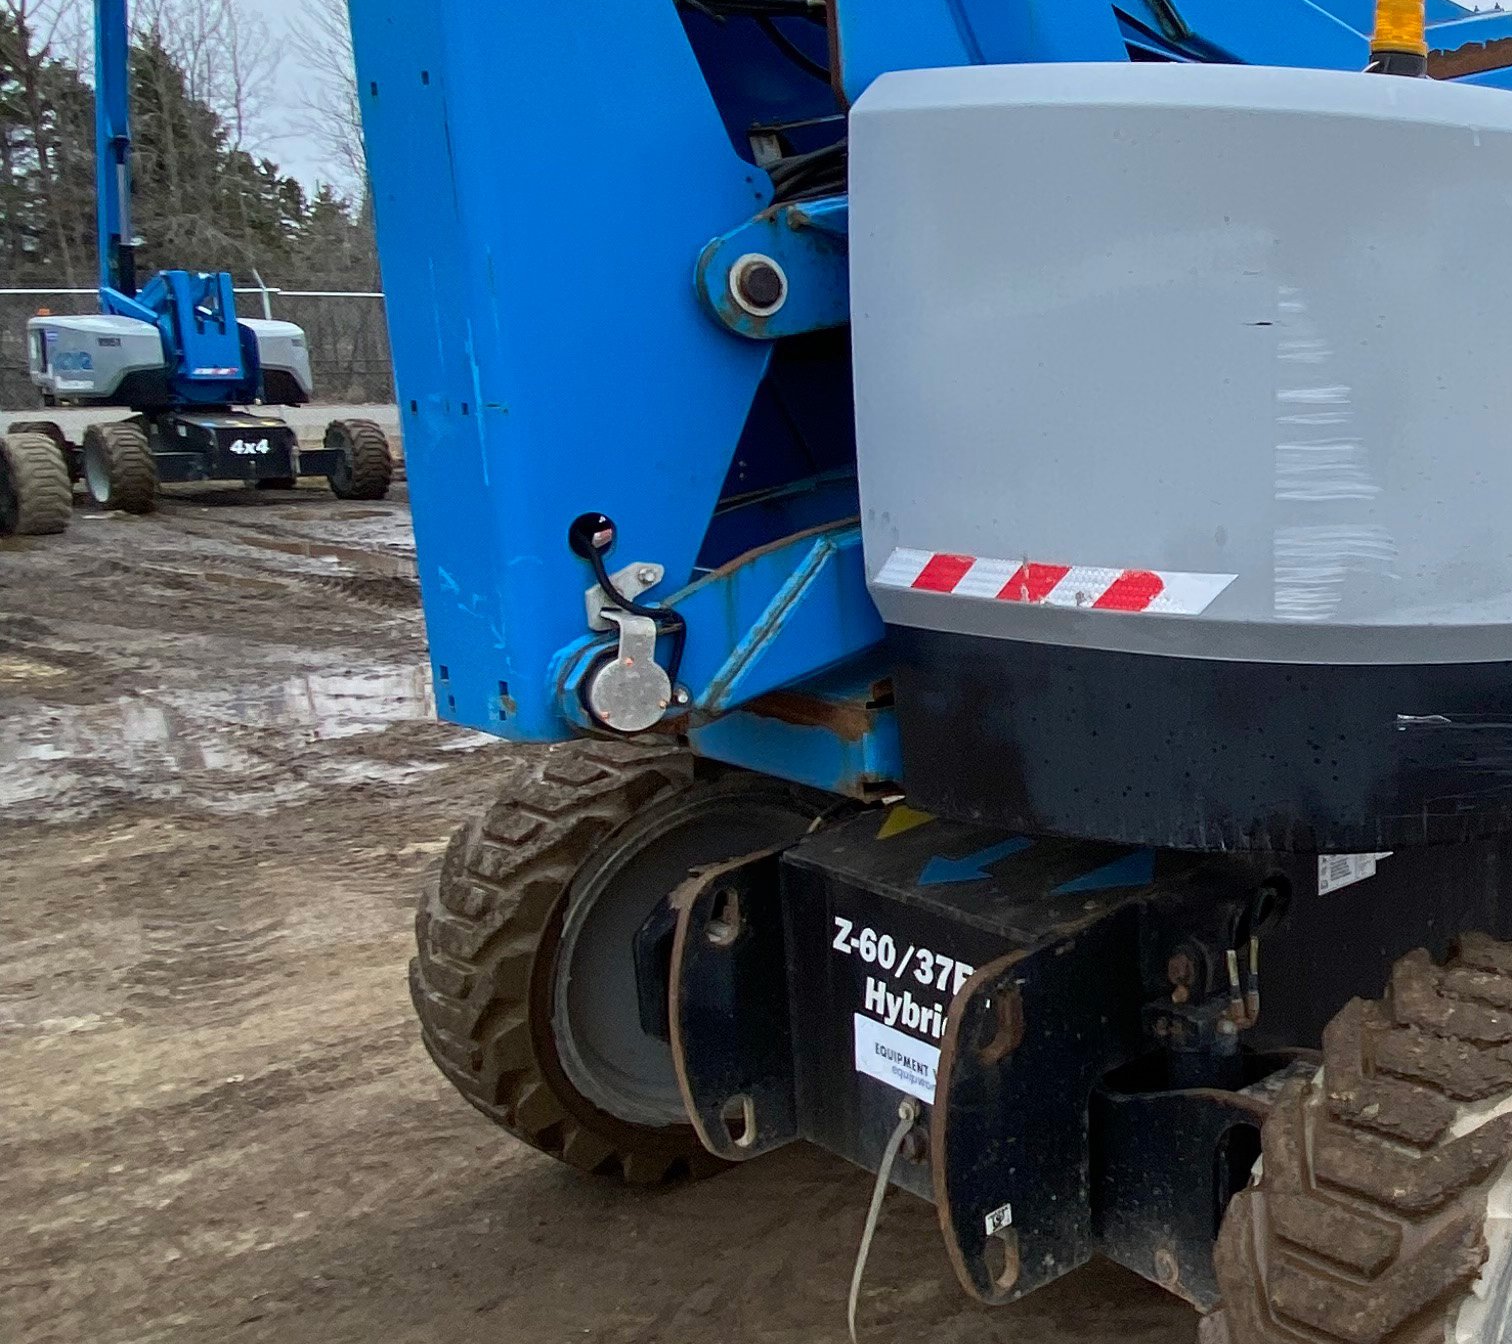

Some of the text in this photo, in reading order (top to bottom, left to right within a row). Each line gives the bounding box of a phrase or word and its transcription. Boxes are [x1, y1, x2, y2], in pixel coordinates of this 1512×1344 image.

[229, 439, 270, 454] 4x4
[832, 916, 976, 995] Z-60/37F
[875, 1041, 929, 1077] EQUIPMENT
